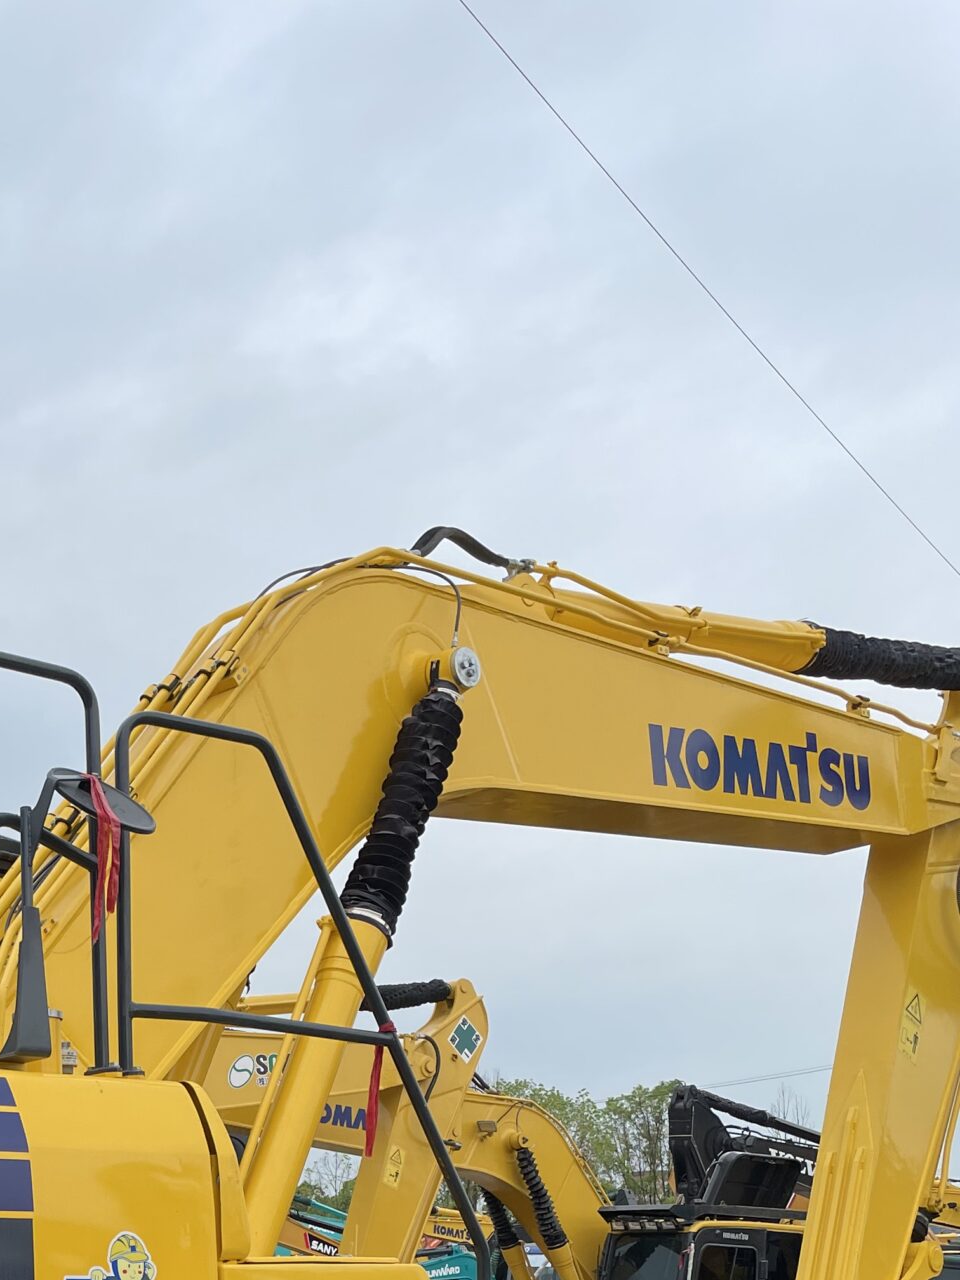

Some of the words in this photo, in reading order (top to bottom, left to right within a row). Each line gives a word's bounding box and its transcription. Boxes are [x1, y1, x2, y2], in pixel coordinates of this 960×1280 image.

[648, 723, 871, 811] KOMATSU
[433, 1224, 471, 1240] KOMATS
[310, 1240, 338, 1256] SANY
